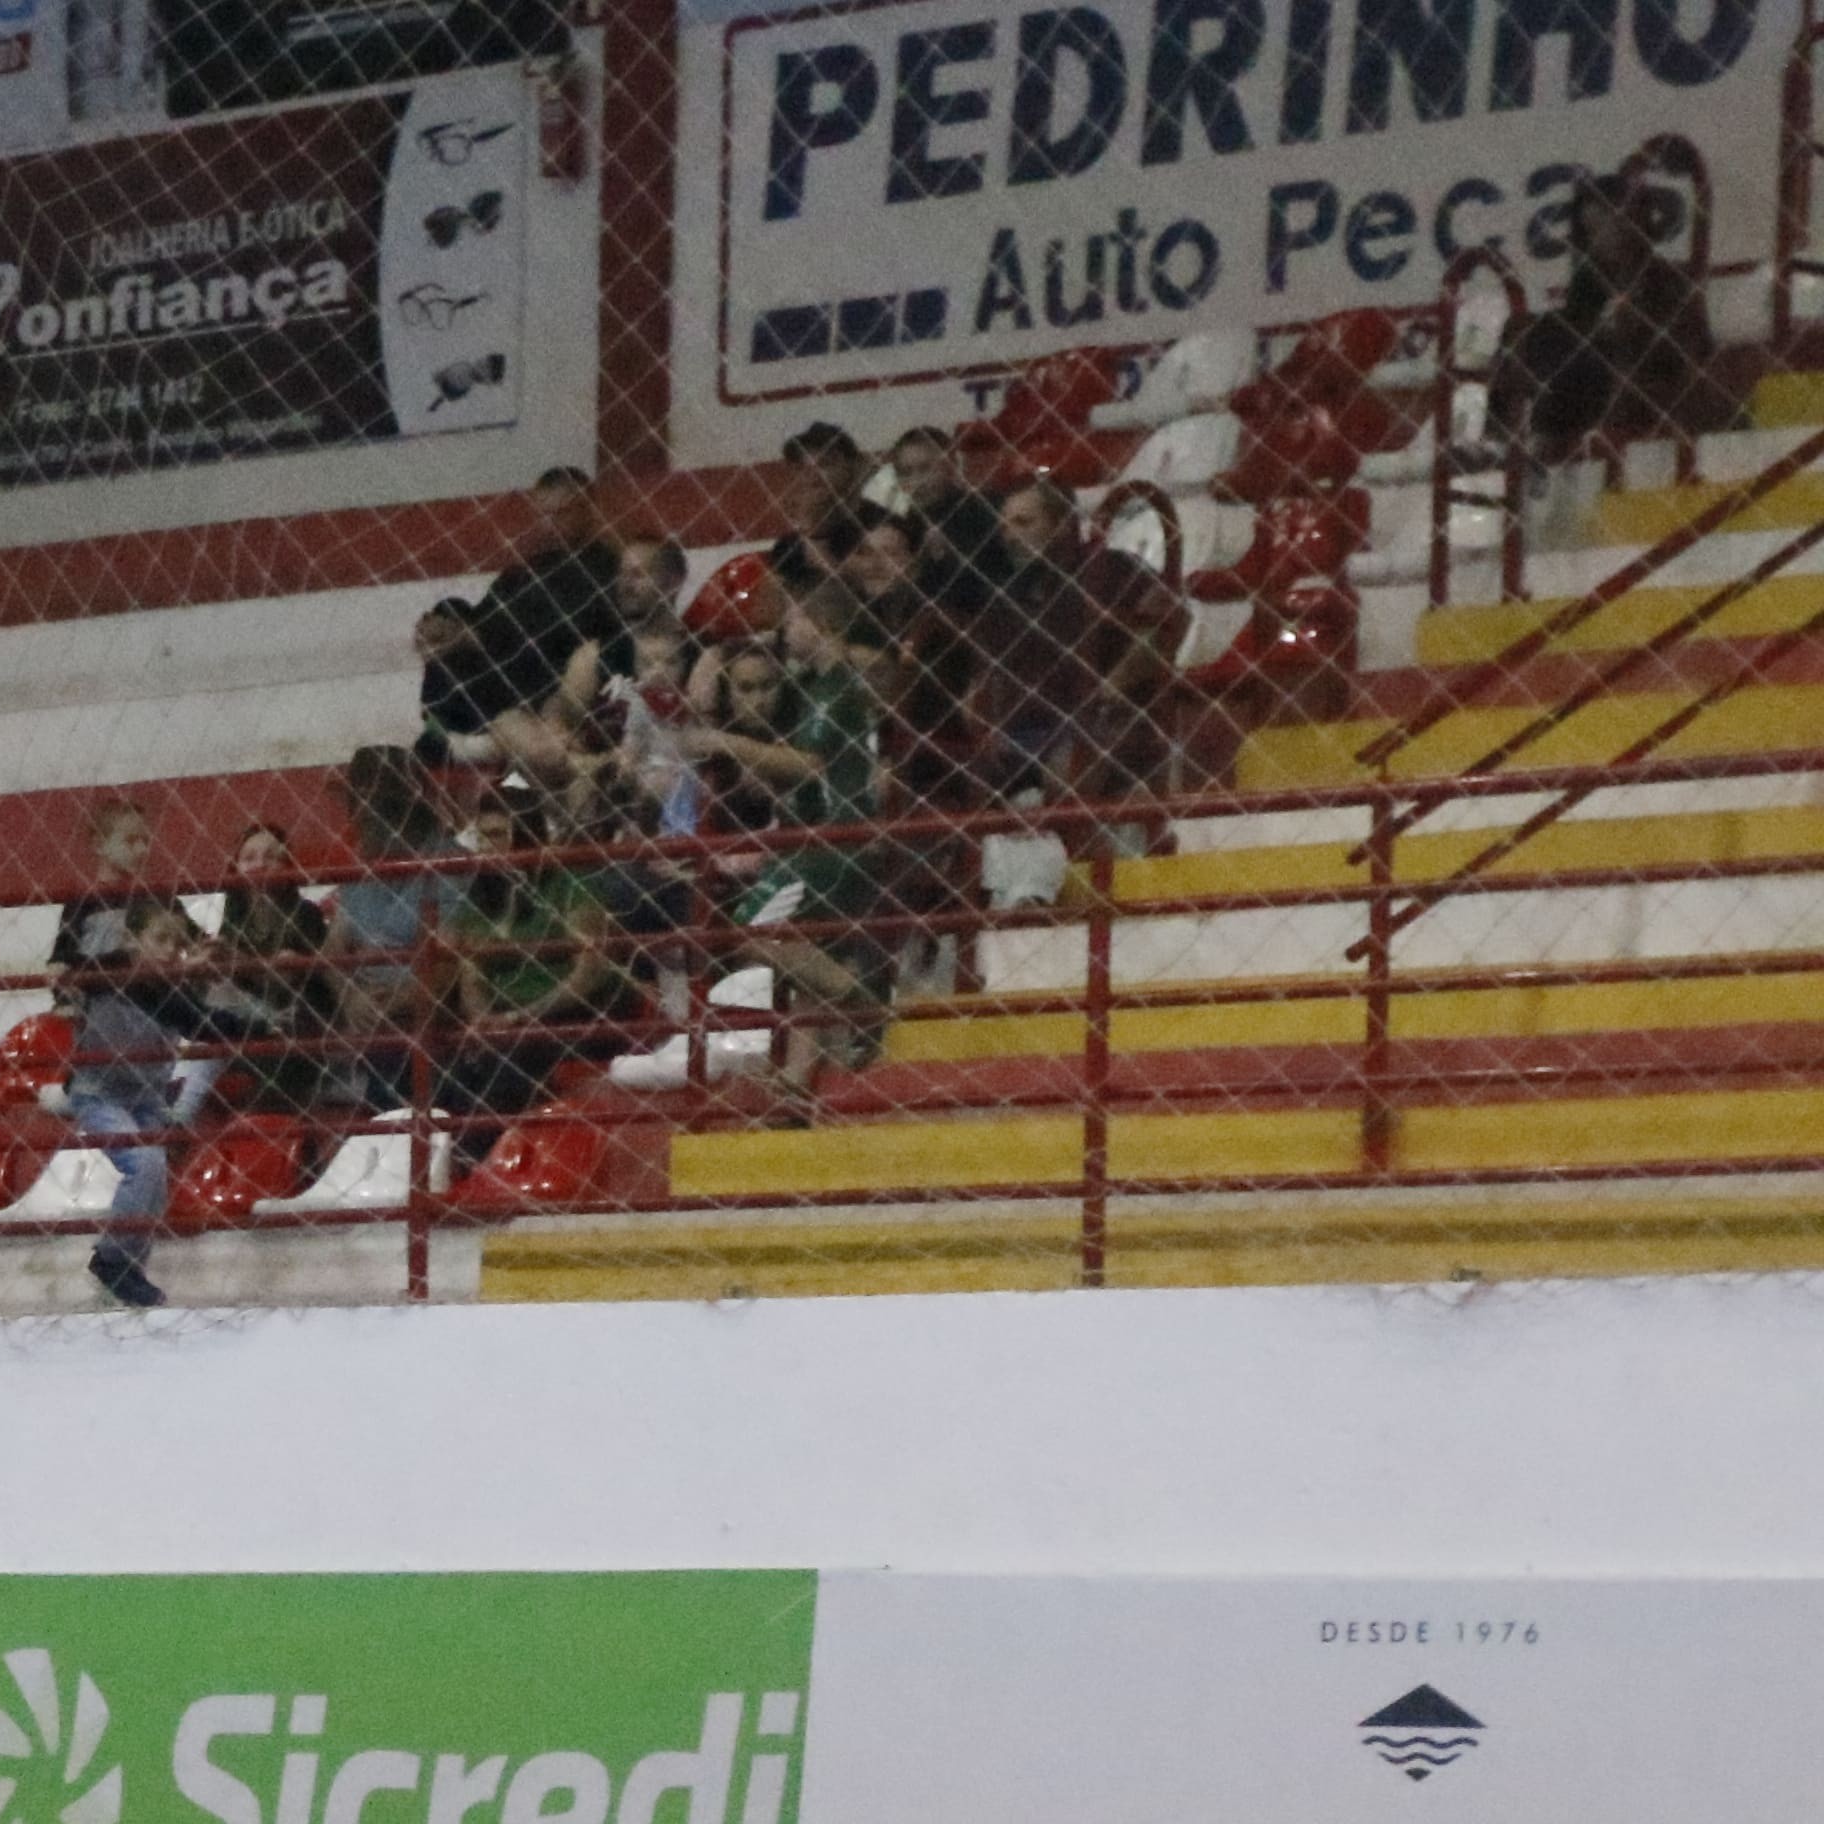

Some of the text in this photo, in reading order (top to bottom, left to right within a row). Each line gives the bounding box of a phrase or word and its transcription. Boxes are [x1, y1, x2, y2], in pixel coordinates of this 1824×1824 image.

[762, 0, 1754, 221] PEDRINHO
[972, 206, 1226, 336] Auto
[1319, 1620, 1542, 1646] DESDE 1976
